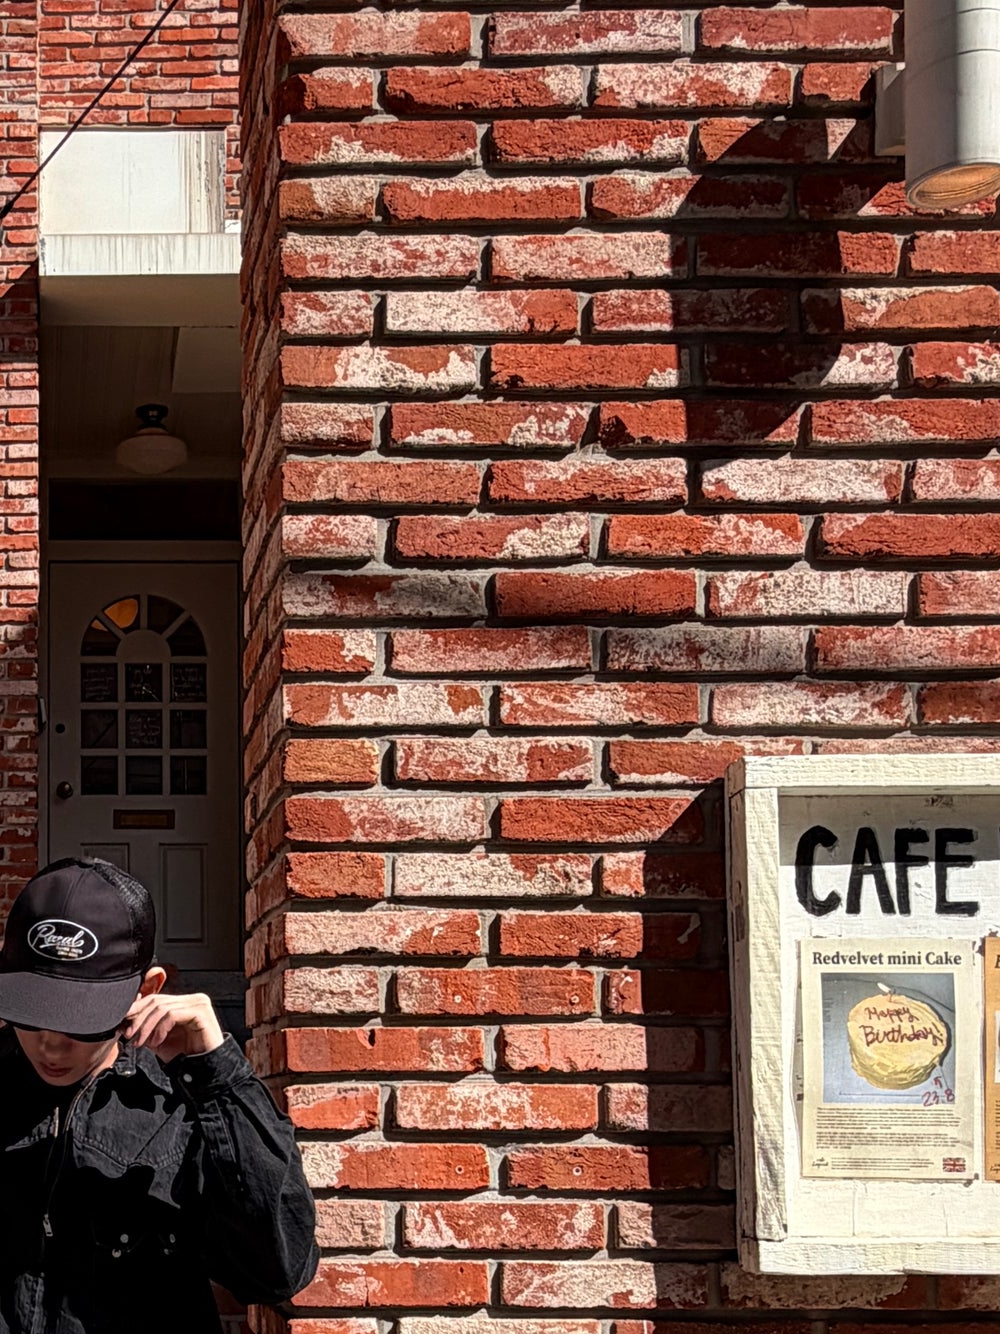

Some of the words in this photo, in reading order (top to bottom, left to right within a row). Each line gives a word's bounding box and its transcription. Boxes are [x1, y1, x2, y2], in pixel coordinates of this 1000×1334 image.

[794, 824, 980, 917] CAFE
[812, 951, 884, 966] Redvelvet
[888, 951, 922, 966] mini
[925, 951, 962, 966] Cake
[864, 1005, 919, 1023] Happy
